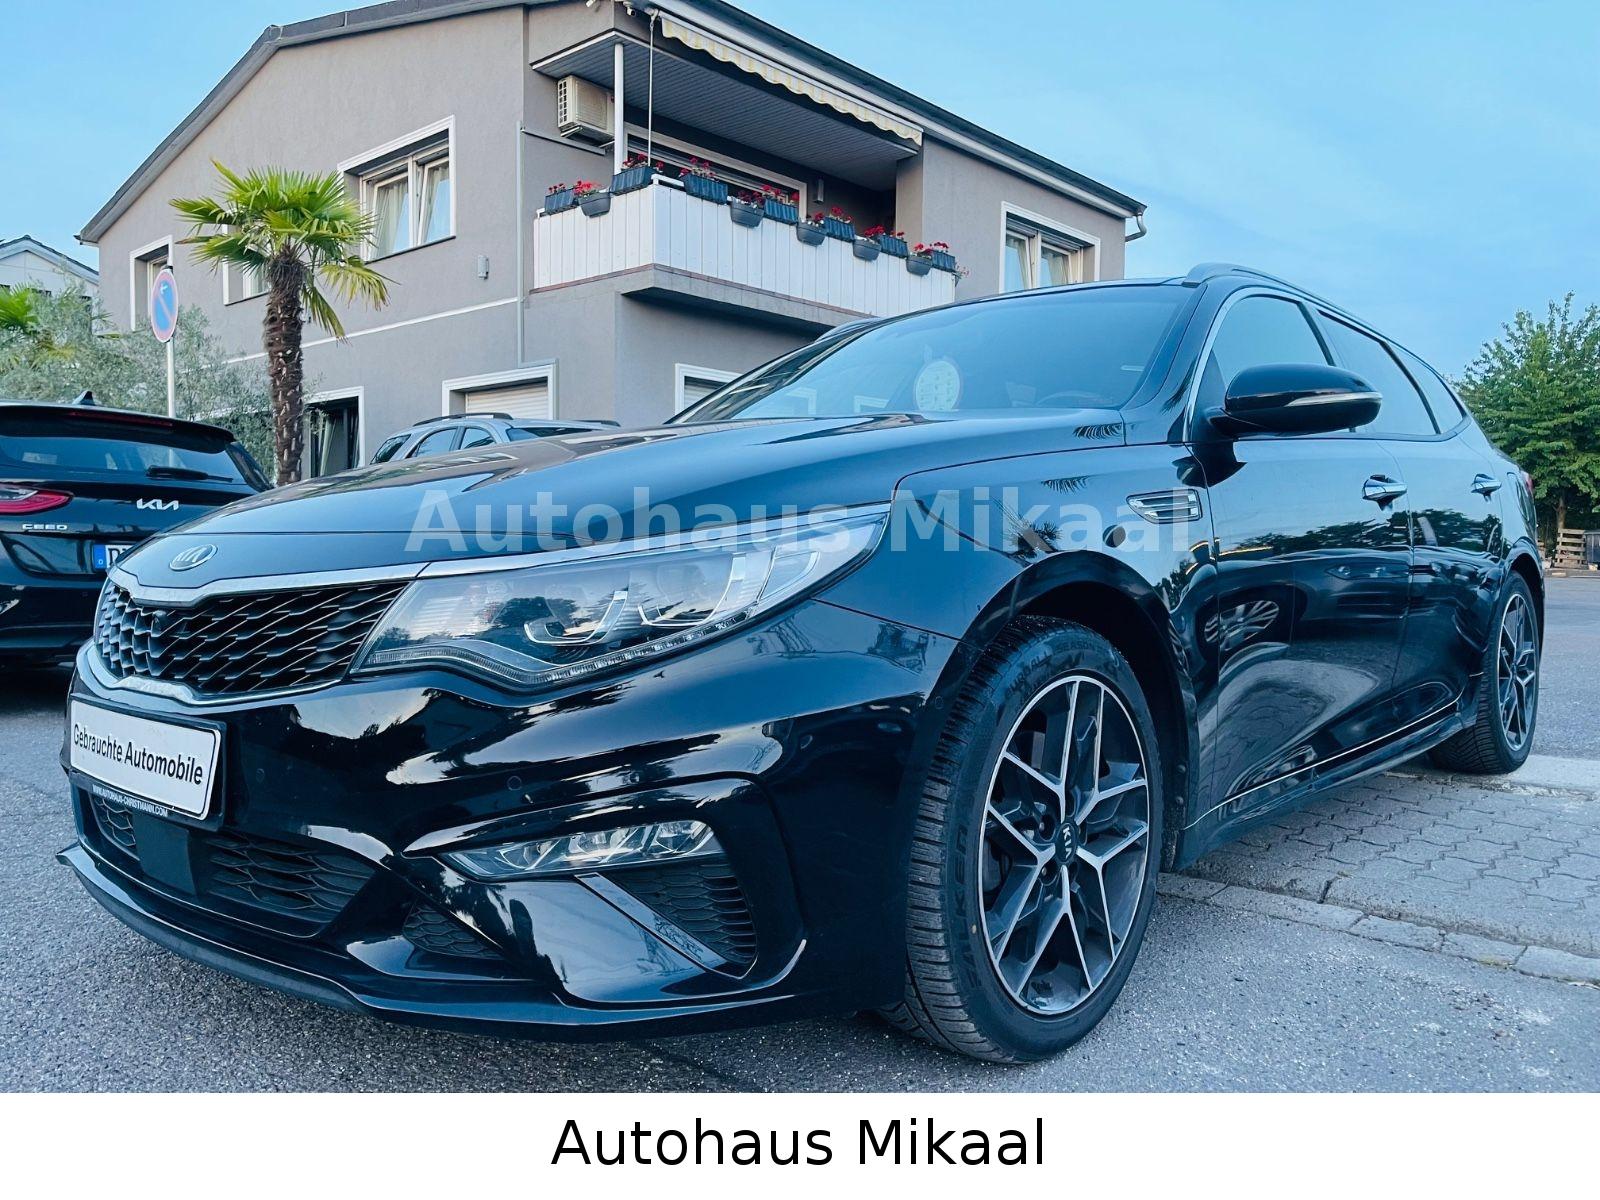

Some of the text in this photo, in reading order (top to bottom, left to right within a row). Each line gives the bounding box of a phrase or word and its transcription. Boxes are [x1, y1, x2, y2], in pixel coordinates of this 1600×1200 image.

[74, 723, 203, 785] Gebrauchte Automobile
[1062, 825, 1073, 860] KIA
